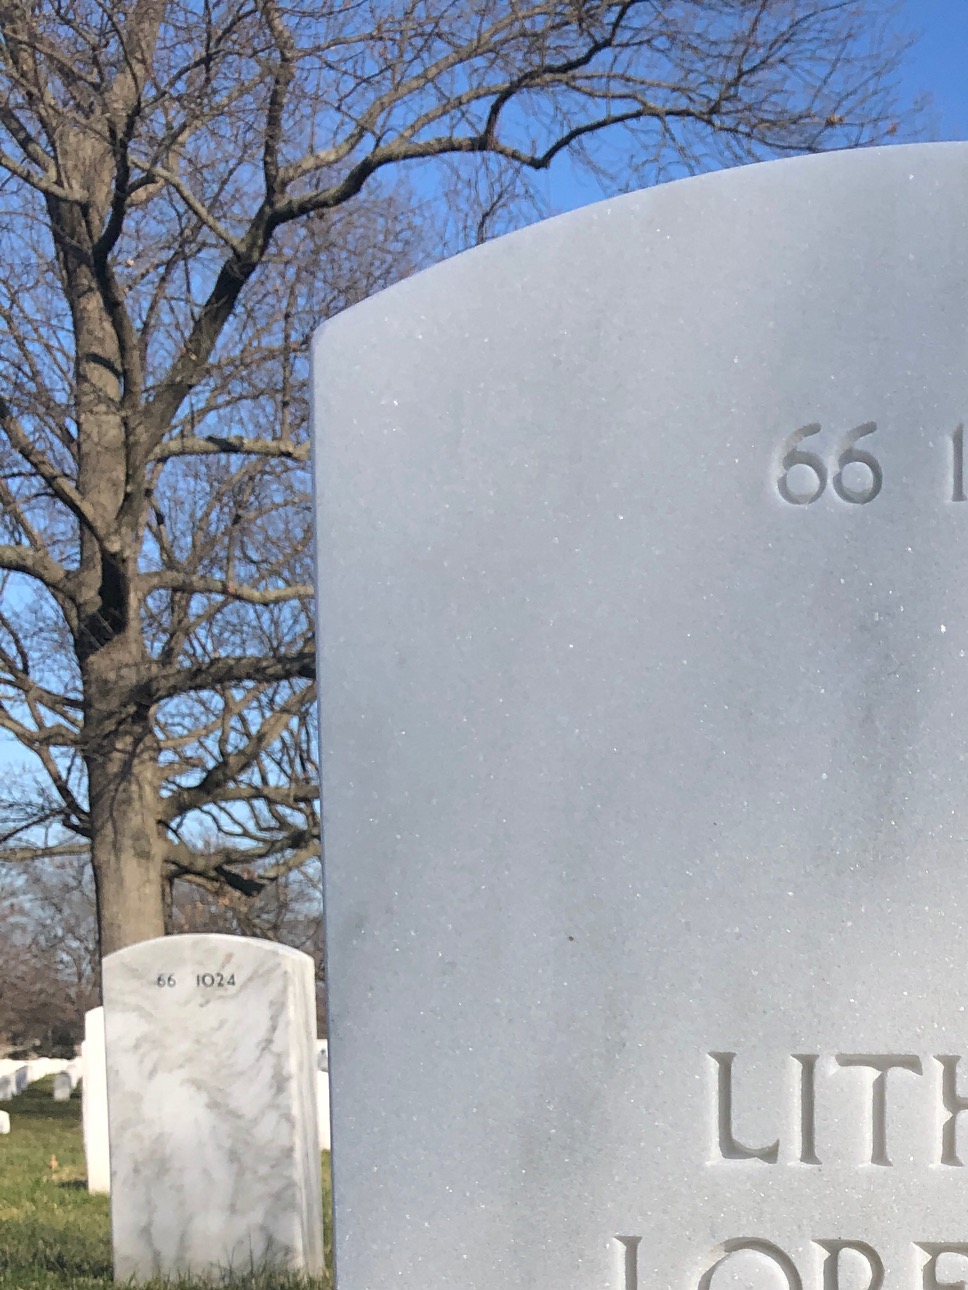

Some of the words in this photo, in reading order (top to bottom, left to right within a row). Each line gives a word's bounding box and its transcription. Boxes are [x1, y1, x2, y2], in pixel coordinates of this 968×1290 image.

[776, 420, 884, 506] 66
[156, 973, 177, 988] 66
[196, 972, 236, 988] 1024
